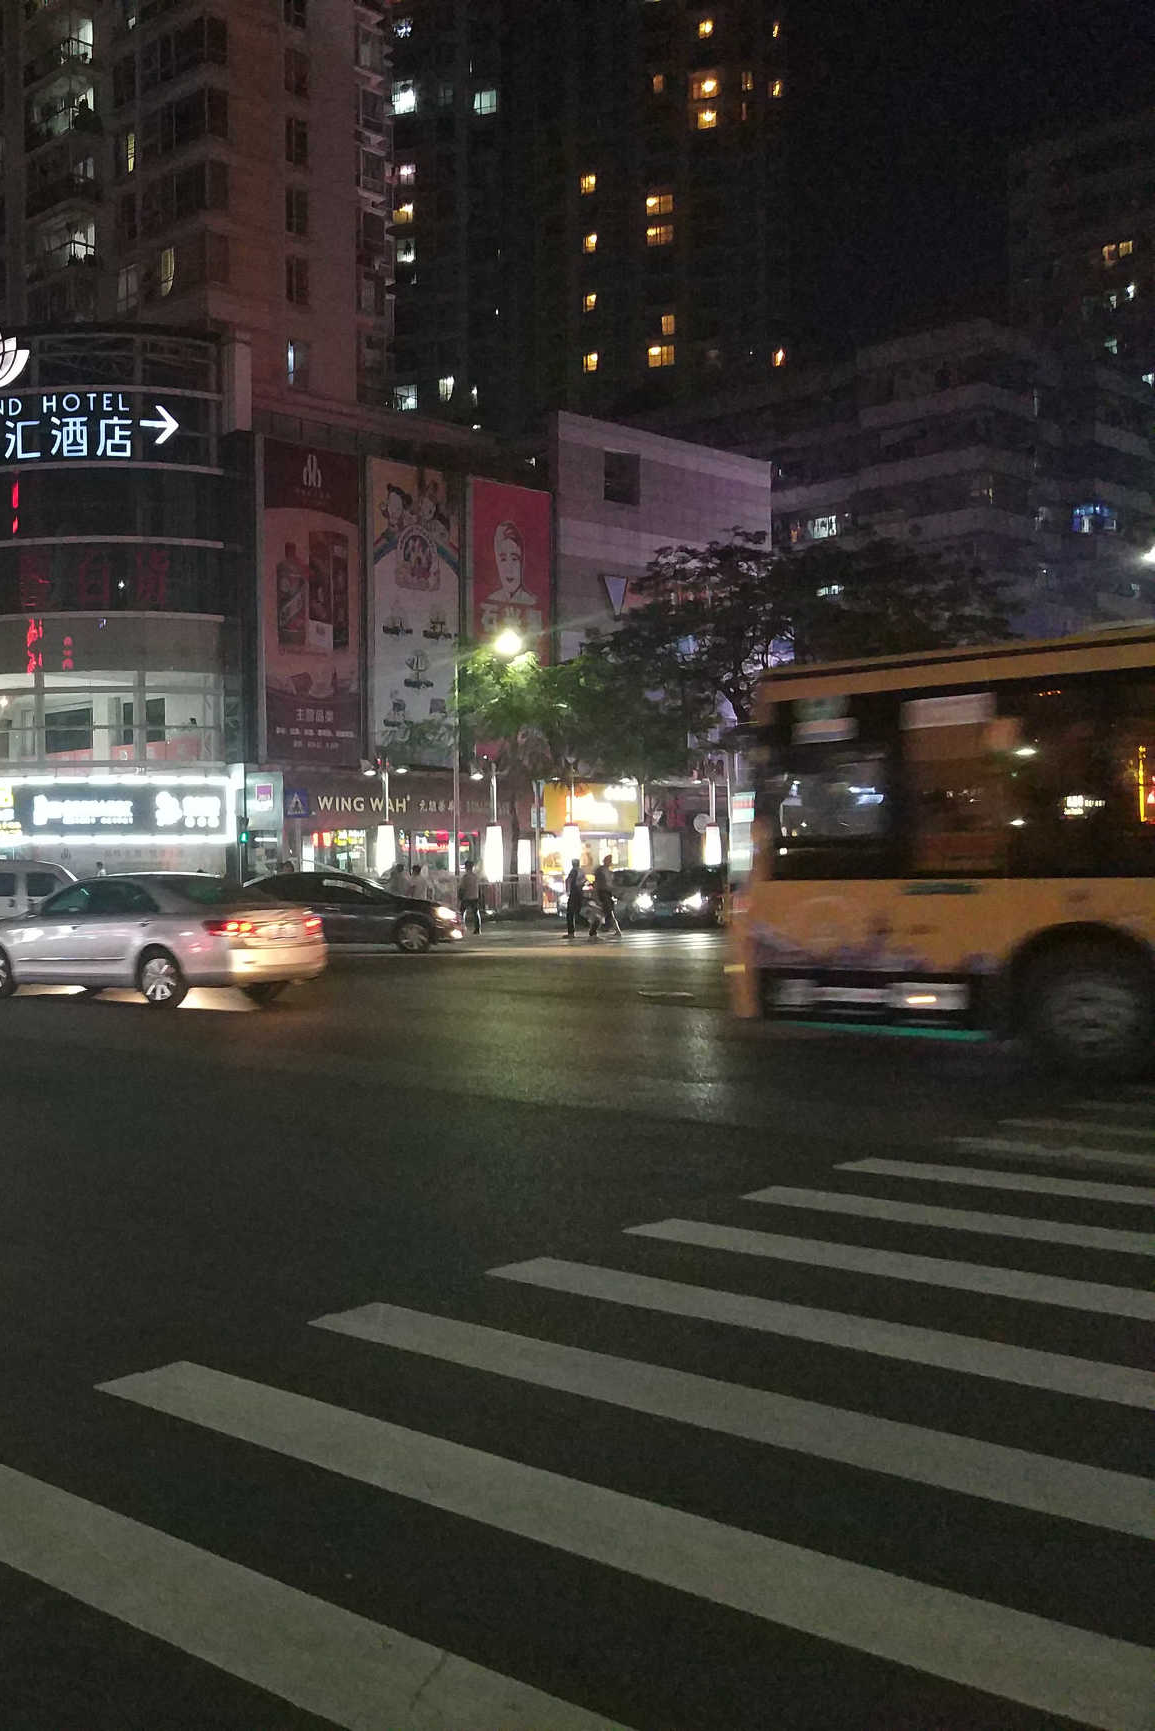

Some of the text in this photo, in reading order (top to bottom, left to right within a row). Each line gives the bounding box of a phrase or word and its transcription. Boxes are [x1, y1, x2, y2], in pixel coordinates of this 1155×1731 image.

[42, 393, 130, 413] HOTEL
[317, 795, 407, 813] WING WAH
